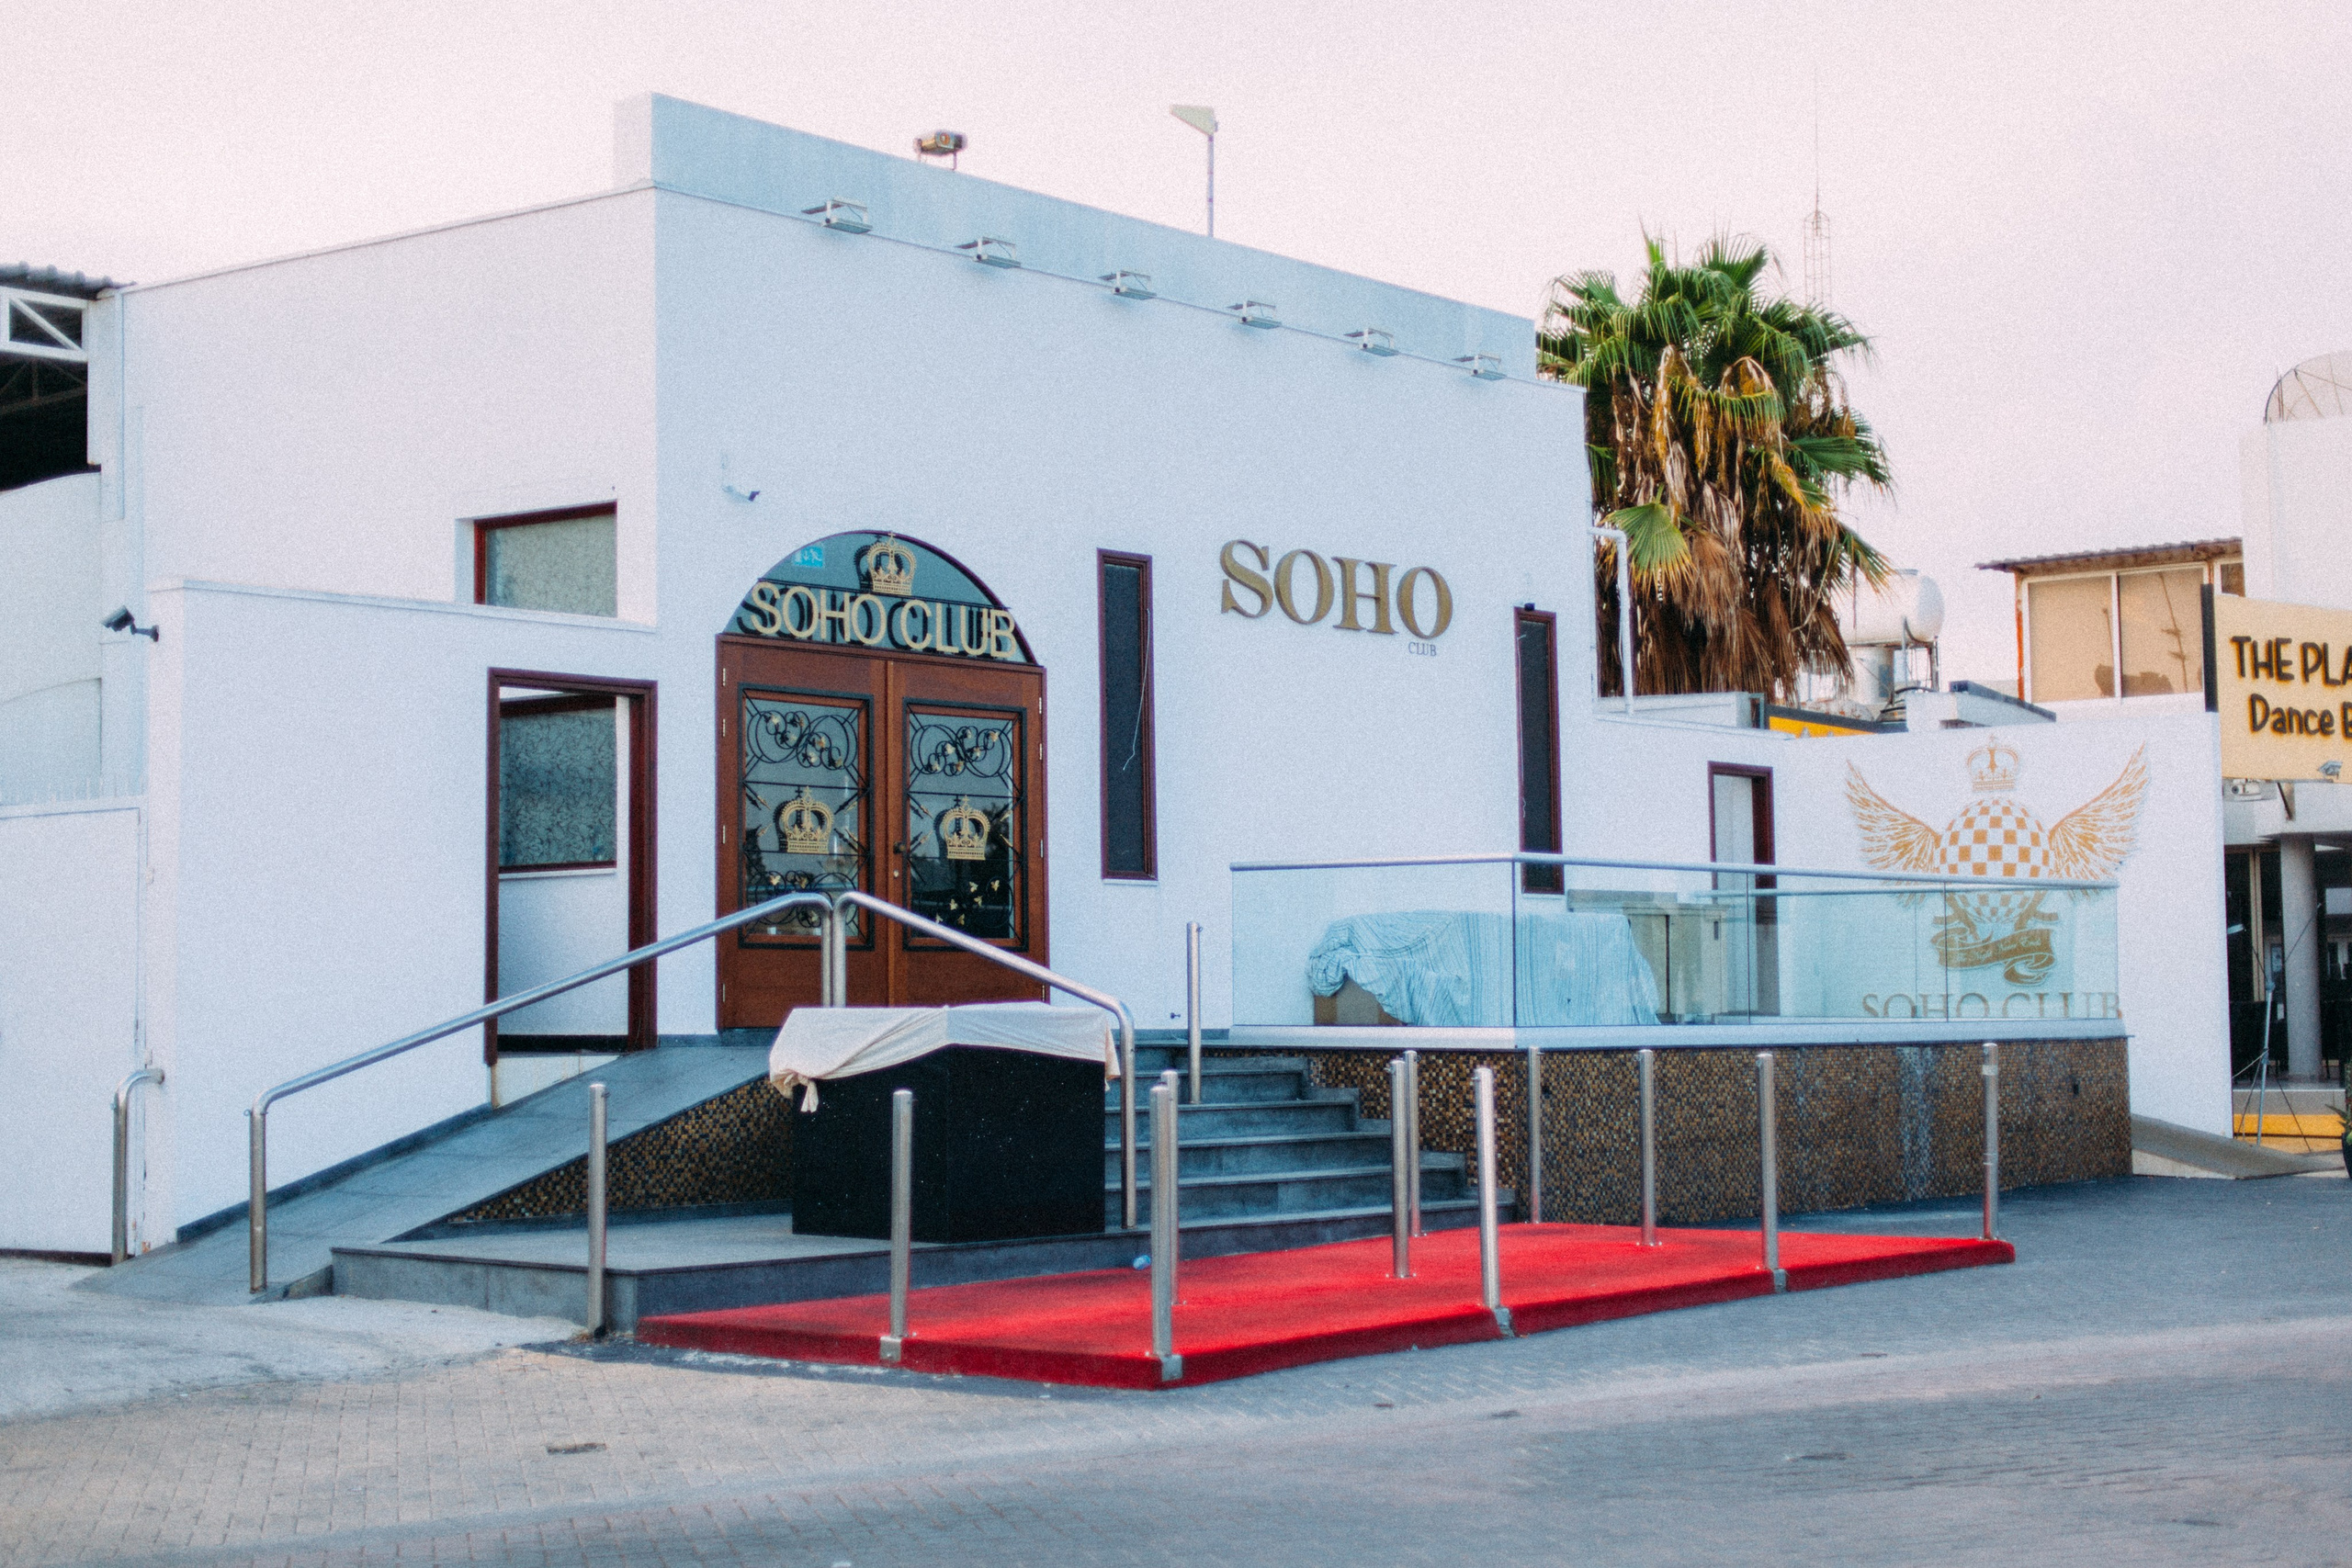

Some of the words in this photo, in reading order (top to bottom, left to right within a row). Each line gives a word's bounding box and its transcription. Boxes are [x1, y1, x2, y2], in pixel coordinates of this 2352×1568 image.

[1219, 538, 1453, 640] SOHO
[750, 581, 887, 645] SOHO
[899, 599, 1017, 659] CLUB
[1408, 641, 1437, 657] CLUB
[2230, 636, 2294, 681] THE
[2249, 694, 2335, 736] Dance
